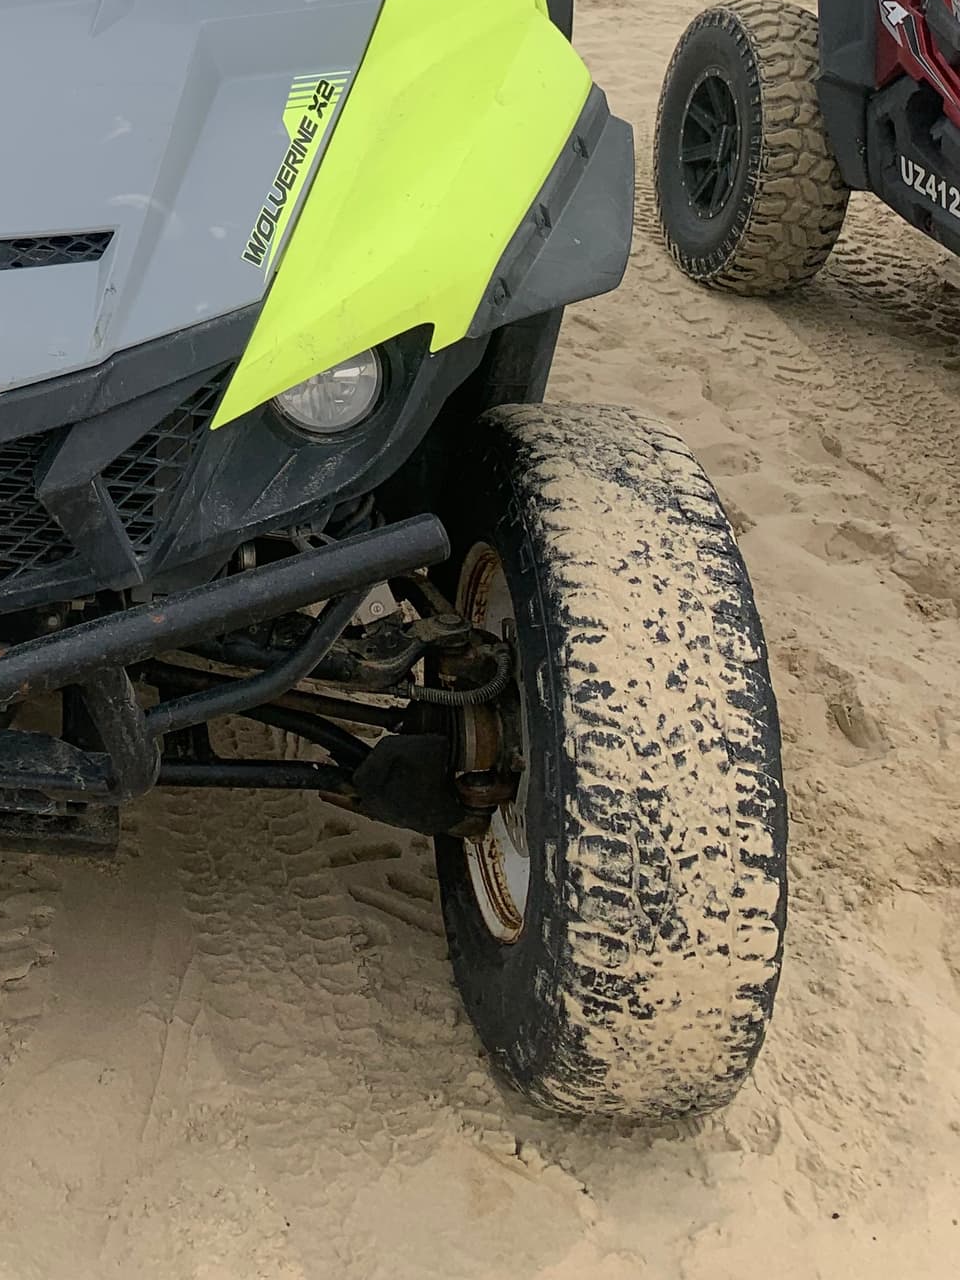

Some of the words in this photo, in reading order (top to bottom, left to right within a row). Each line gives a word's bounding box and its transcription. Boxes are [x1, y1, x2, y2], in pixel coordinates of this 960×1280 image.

[243, 115, 318, 266] WOLVERINE
[307, 79, 335, 119] X2
[901, 155, 960, 218] UZ412
